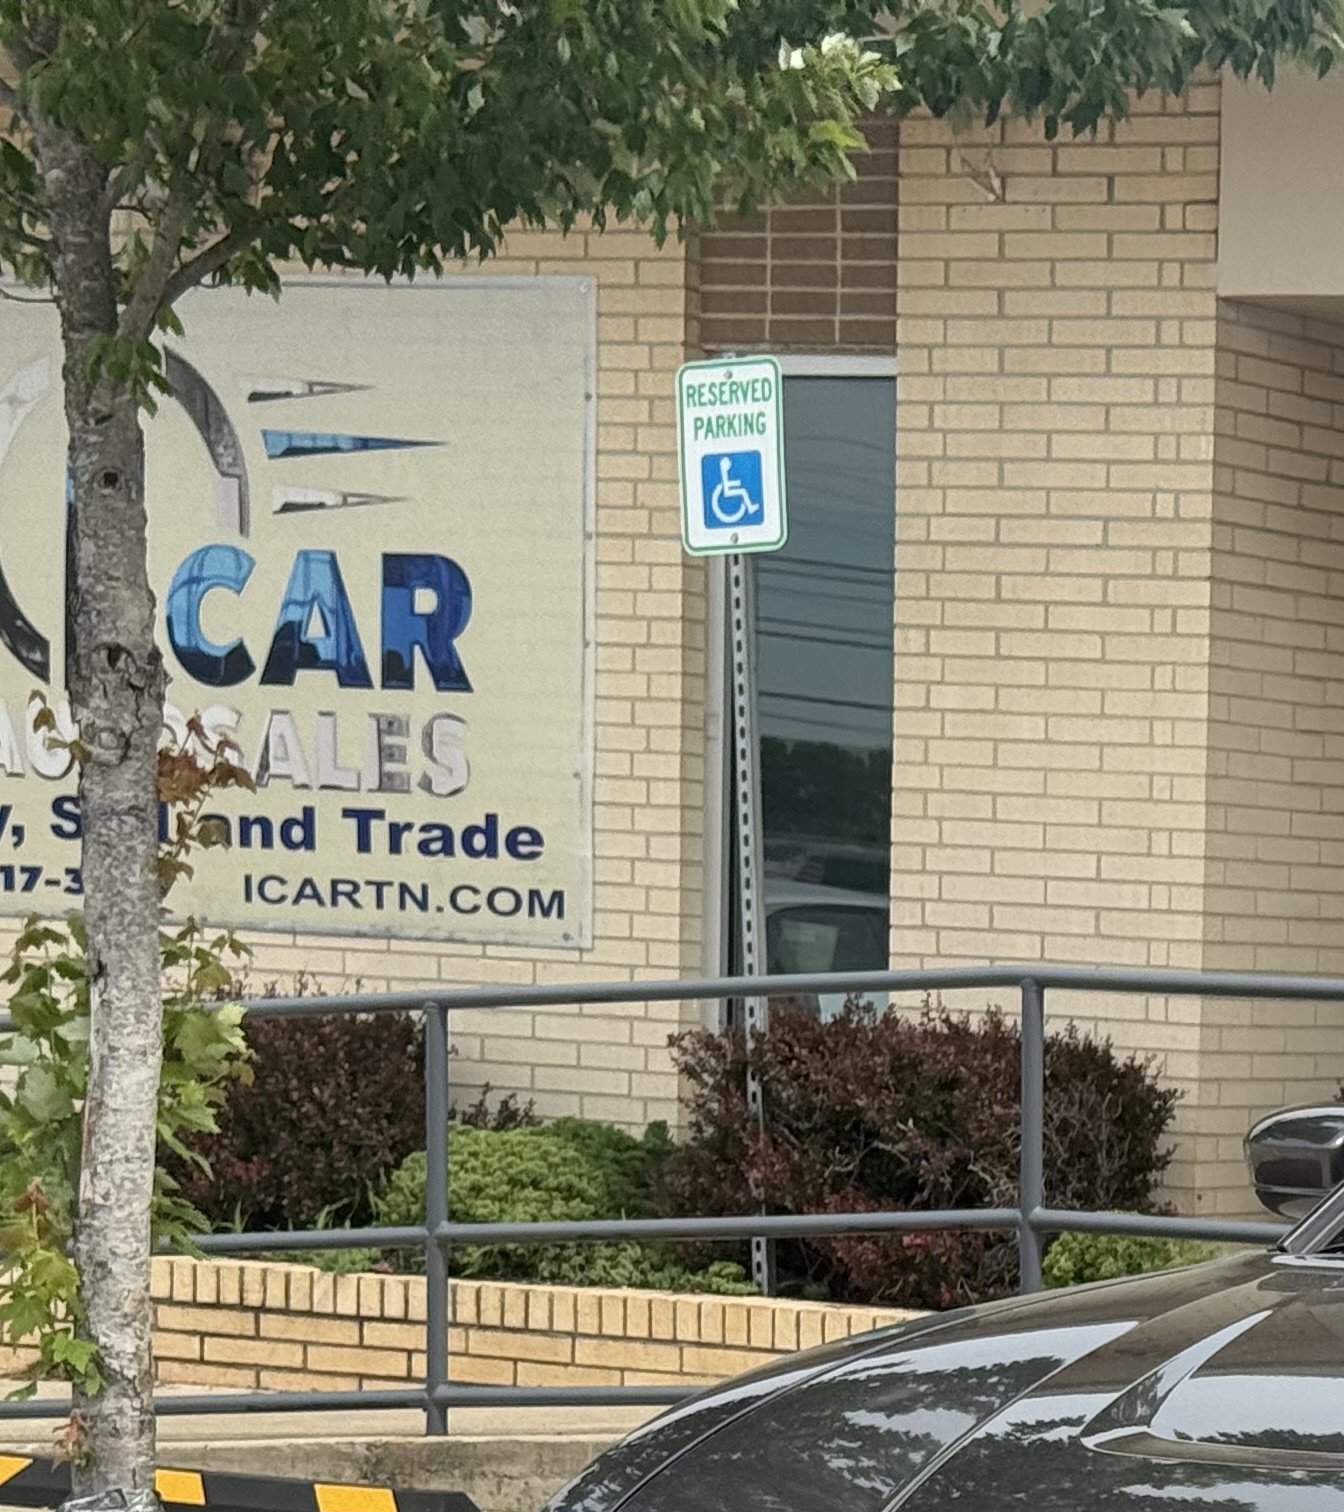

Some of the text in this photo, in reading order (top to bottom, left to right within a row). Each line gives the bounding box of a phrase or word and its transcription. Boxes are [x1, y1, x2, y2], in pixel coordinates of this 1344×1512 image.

[686, 376, 773, 409] RESERVED
[693, 411, 768, 442] PARKING
[342, 806, 545, 861] Trade
[243, 873, 566, 920] ICARTN.COM
